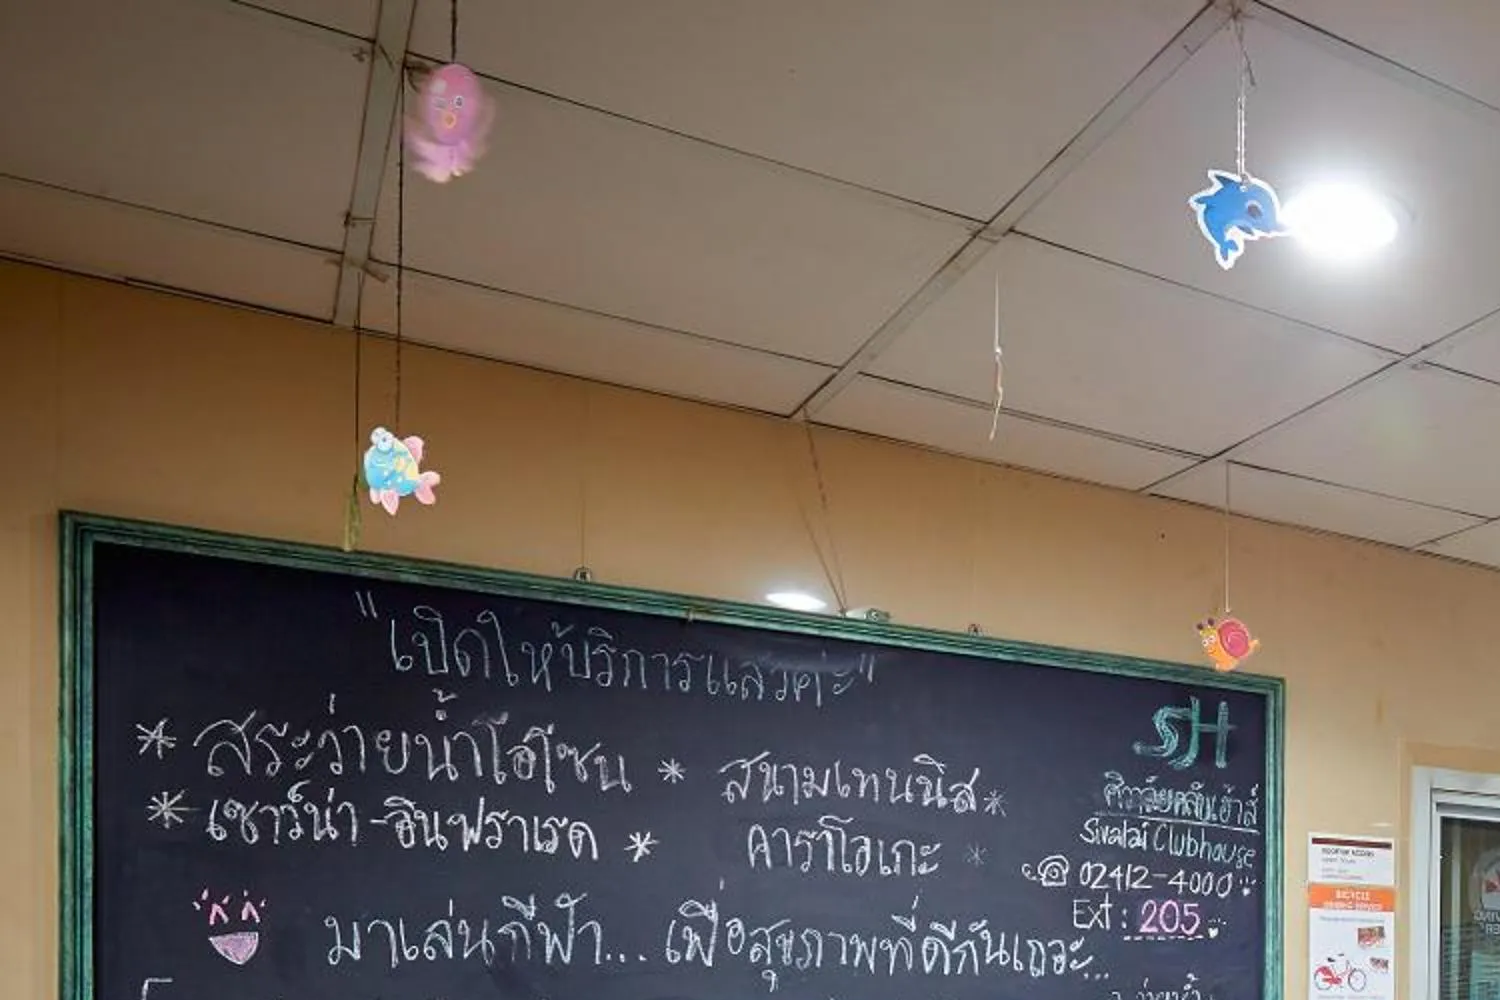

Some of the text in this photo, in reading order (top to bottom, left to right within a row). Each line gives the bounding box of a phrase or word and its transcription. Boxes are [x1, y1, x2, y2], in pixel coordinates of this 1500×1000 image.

[1080, 816, 1257, 869] Sivalai Clubhouse
[1139, 899, 1202, 936] 205
